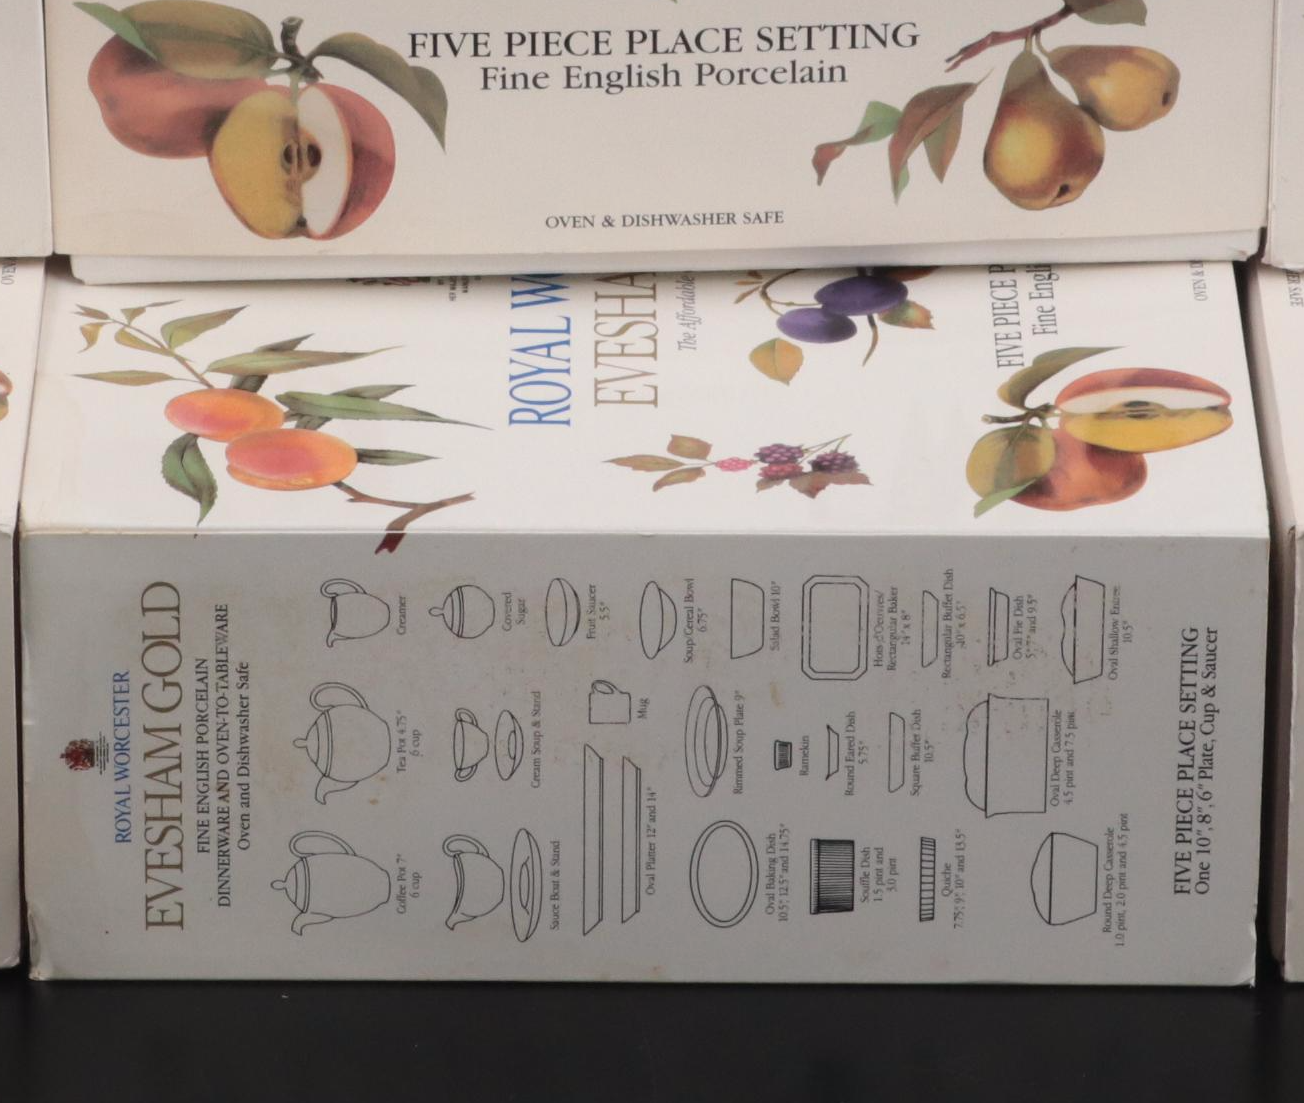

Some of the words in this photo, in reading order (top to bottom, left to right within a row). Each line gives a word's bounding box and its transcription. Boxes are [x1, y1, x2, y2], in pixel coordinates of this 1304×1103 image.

[410, 32, 491, 58] FIVE
[505, 30, 612, 57] PIECE
[627, 27, 743, 55] PLACE
[756, 22, 919, 52] SETTING
[481, 67, 549, 91] Fine
[565, 62, 681, 95] English
[696, 59, 847, 87] Porcelain
[545, 215, 595, 229] OVEN
[601, 215, 615, 228] &
[622, 212, 737, 227] DISHWASHER
[743, 211, 784, 225] SAFE
[988, 278, 1021, 327] PIECE
[1031, 305, 1058, 336] Fine
[508, 316, 572, 426] ROYAL
[993, 331, 1025, 369] FIVE
[140, 581, 183, 714] GOLD
[1179, 627, 1199, 713] SETTING
[195, 658, 209, 745] PORCELAIN
[214, 604, 230, 765] OVEN-TO-TABLEWARE
[112, 671, 131, 782] WORCESTER
[1177, 720, 1196, 781] PLACE
[196, 750, 210, 815] ENGLISH
[215, 769, 230, 803] AND
[114, 785, 132, 843] ROYAL
[143, 723, 185, 931] EVESHAM
[196, 819, 211, 853] FINE
[1175, 788, 1194, 845] PIECE
[217, 806, 231, 907] DINNERWARE
[1173, 851, 1192, 895] FIVE
